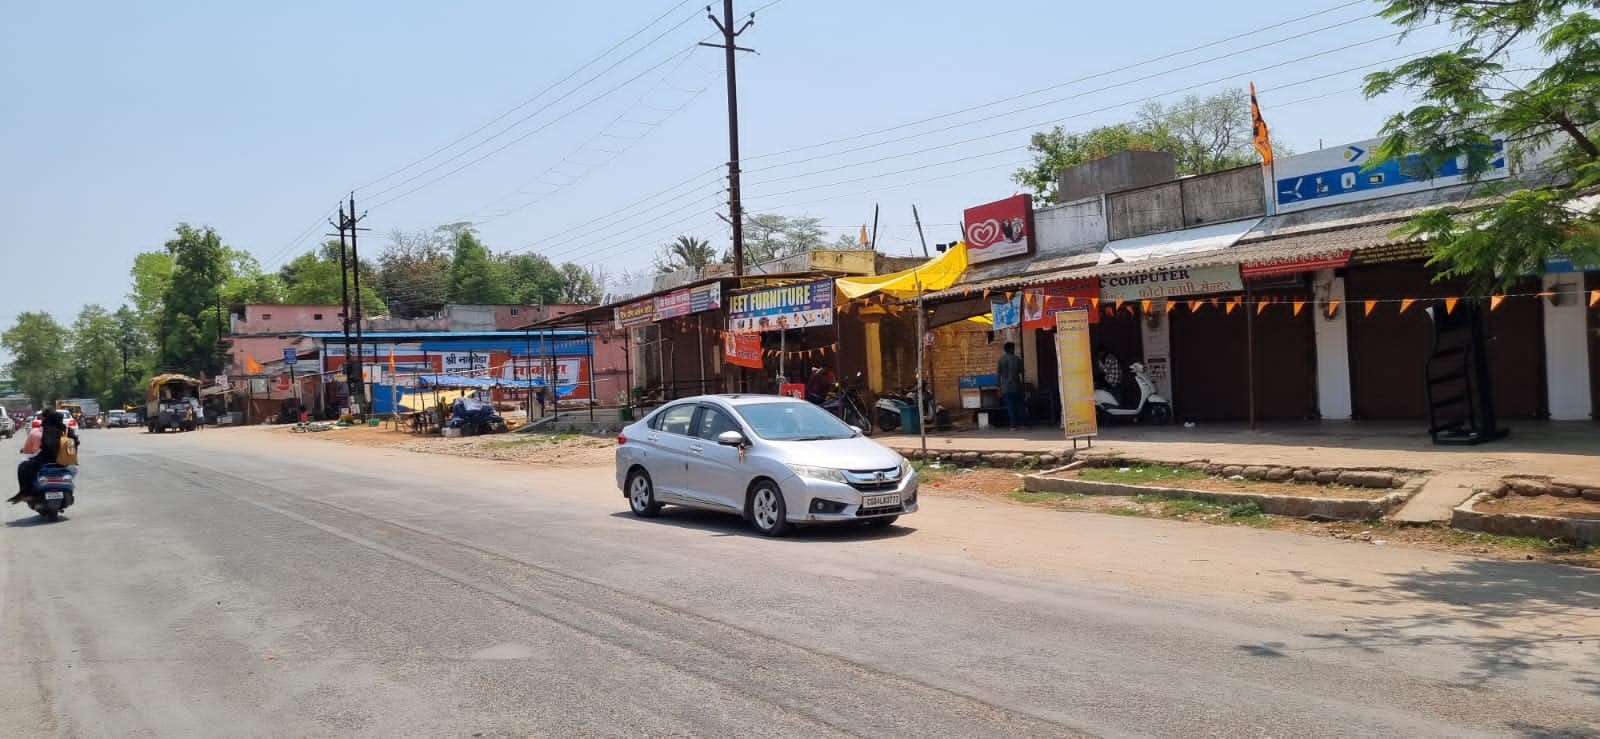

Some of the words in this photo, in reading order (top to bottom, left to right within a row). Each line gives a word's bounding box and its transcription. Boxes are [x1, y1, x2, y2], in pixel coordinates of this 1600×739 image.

[1109, 269, 1190, 287] COMPUTER
[750, 285, 811, 311] FURNITURE
[446, 353, 456, 365] श्री
